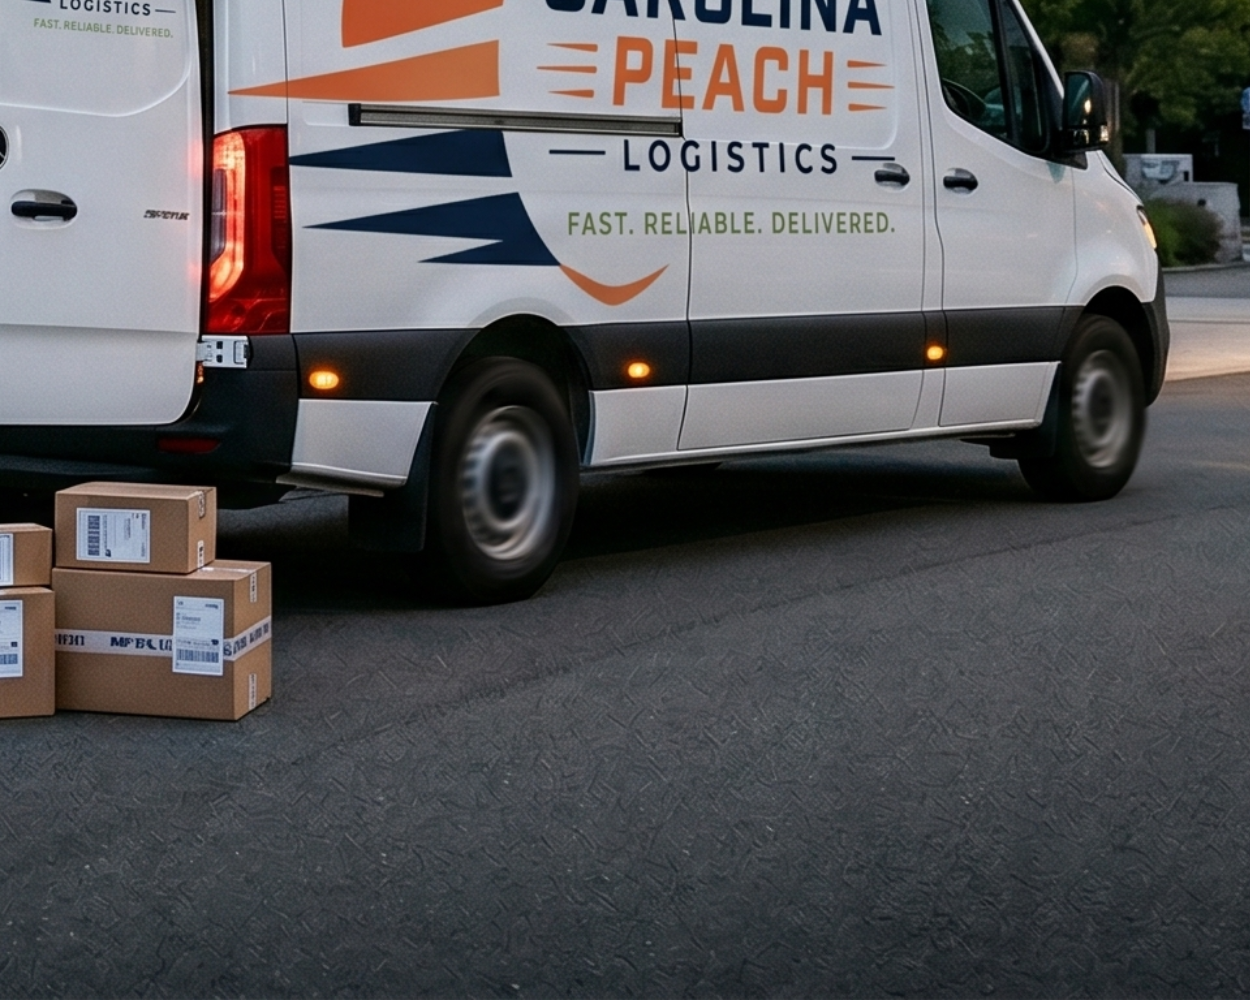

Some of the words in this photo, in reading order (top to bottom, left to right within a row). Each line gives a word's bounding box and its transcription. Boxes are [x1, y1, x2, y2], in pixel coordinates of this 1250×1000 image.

[33, 18, 61, 30] FAST.
[63, 20, 114, 34] RELIABLE.
[116, 25, 174, 39] DELIVERED.
[612, 36, 834, 115] PEACH
[623, 139, 838, 174] LOGISTICS
[567, 212, 634, 236] FAST.
[644, 212, 762, 235] RELIABLE.
[772, 211, 895, 234] DELIVERED.
